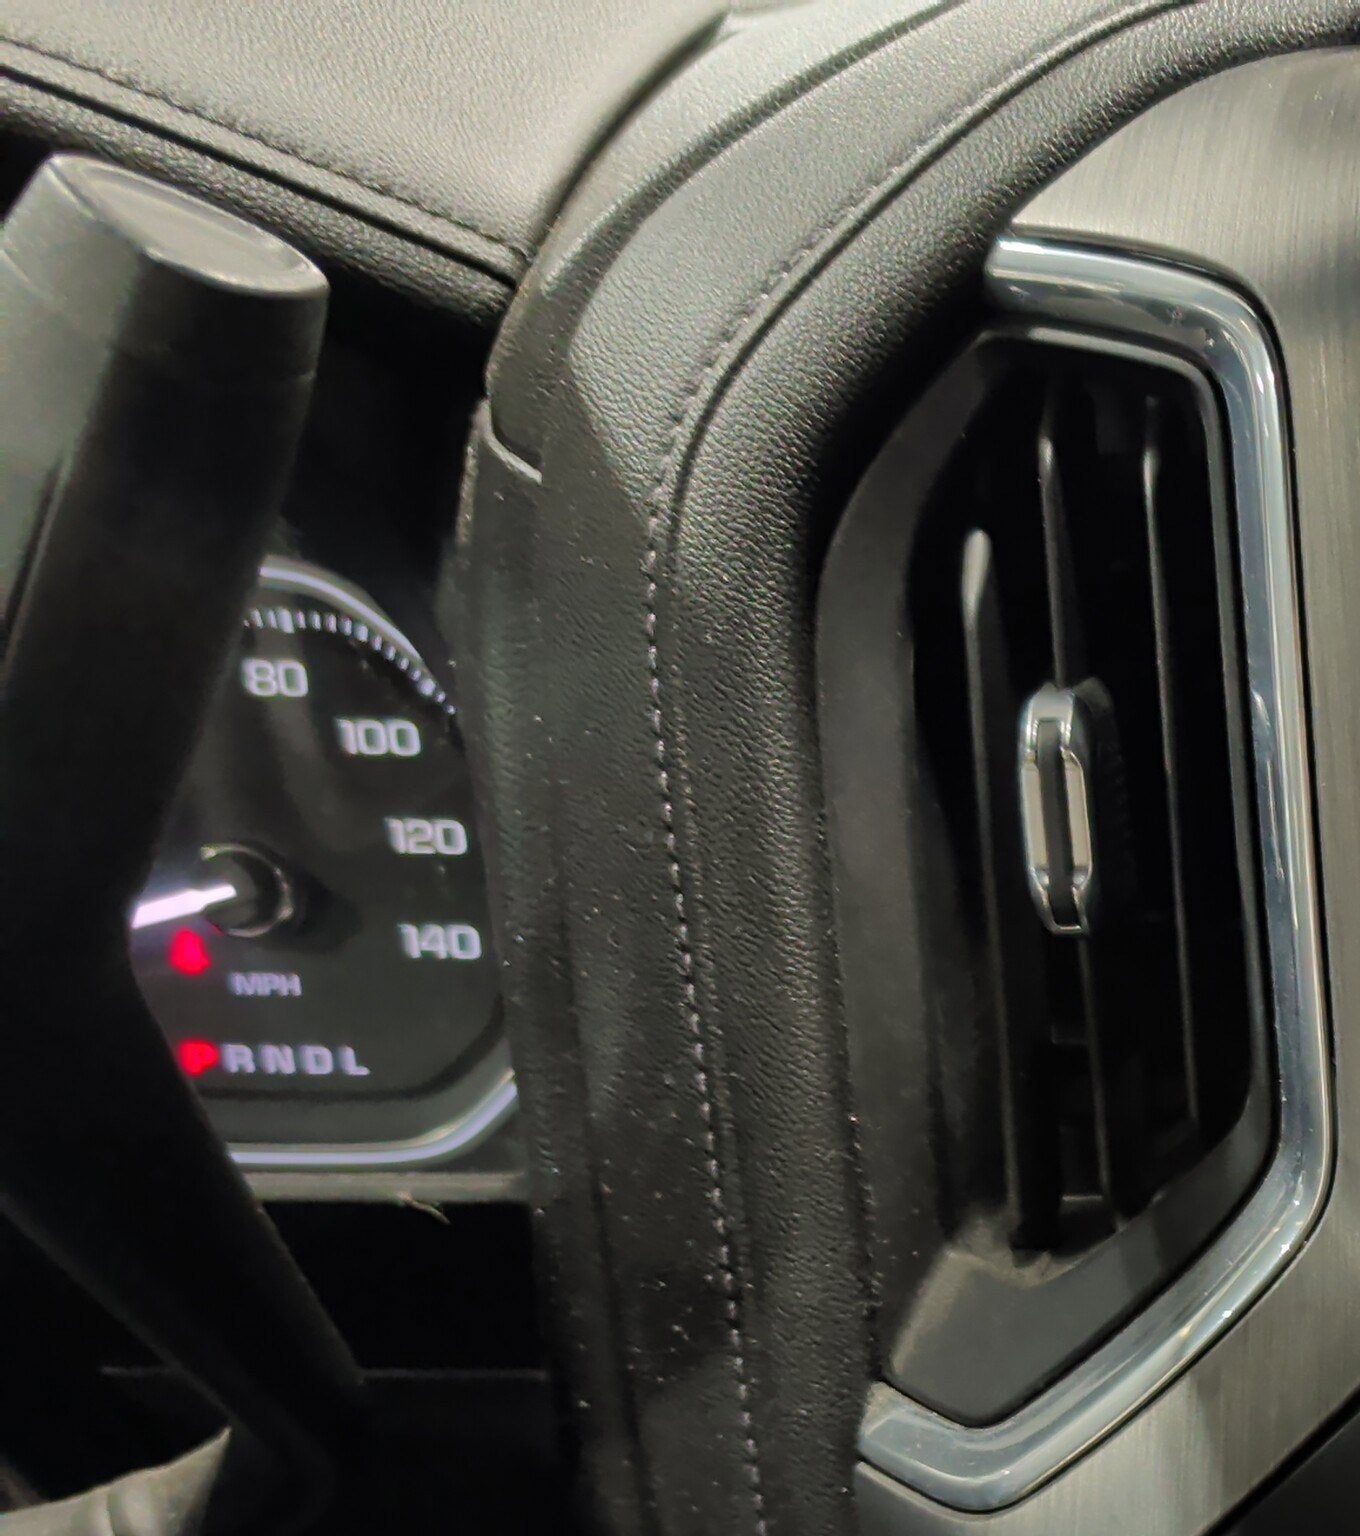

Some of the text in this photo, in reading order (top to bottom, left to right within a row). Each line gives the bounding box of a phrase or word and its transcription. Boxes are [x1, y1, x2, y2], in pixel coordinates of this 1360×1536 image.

[243, 658, 308, 697] 80
[338, 719, 421, 756] 100
[388, 818, 467, 855] 120
[400, 924, 481, 959] 140
[230, 973, 301, 996] MPH
